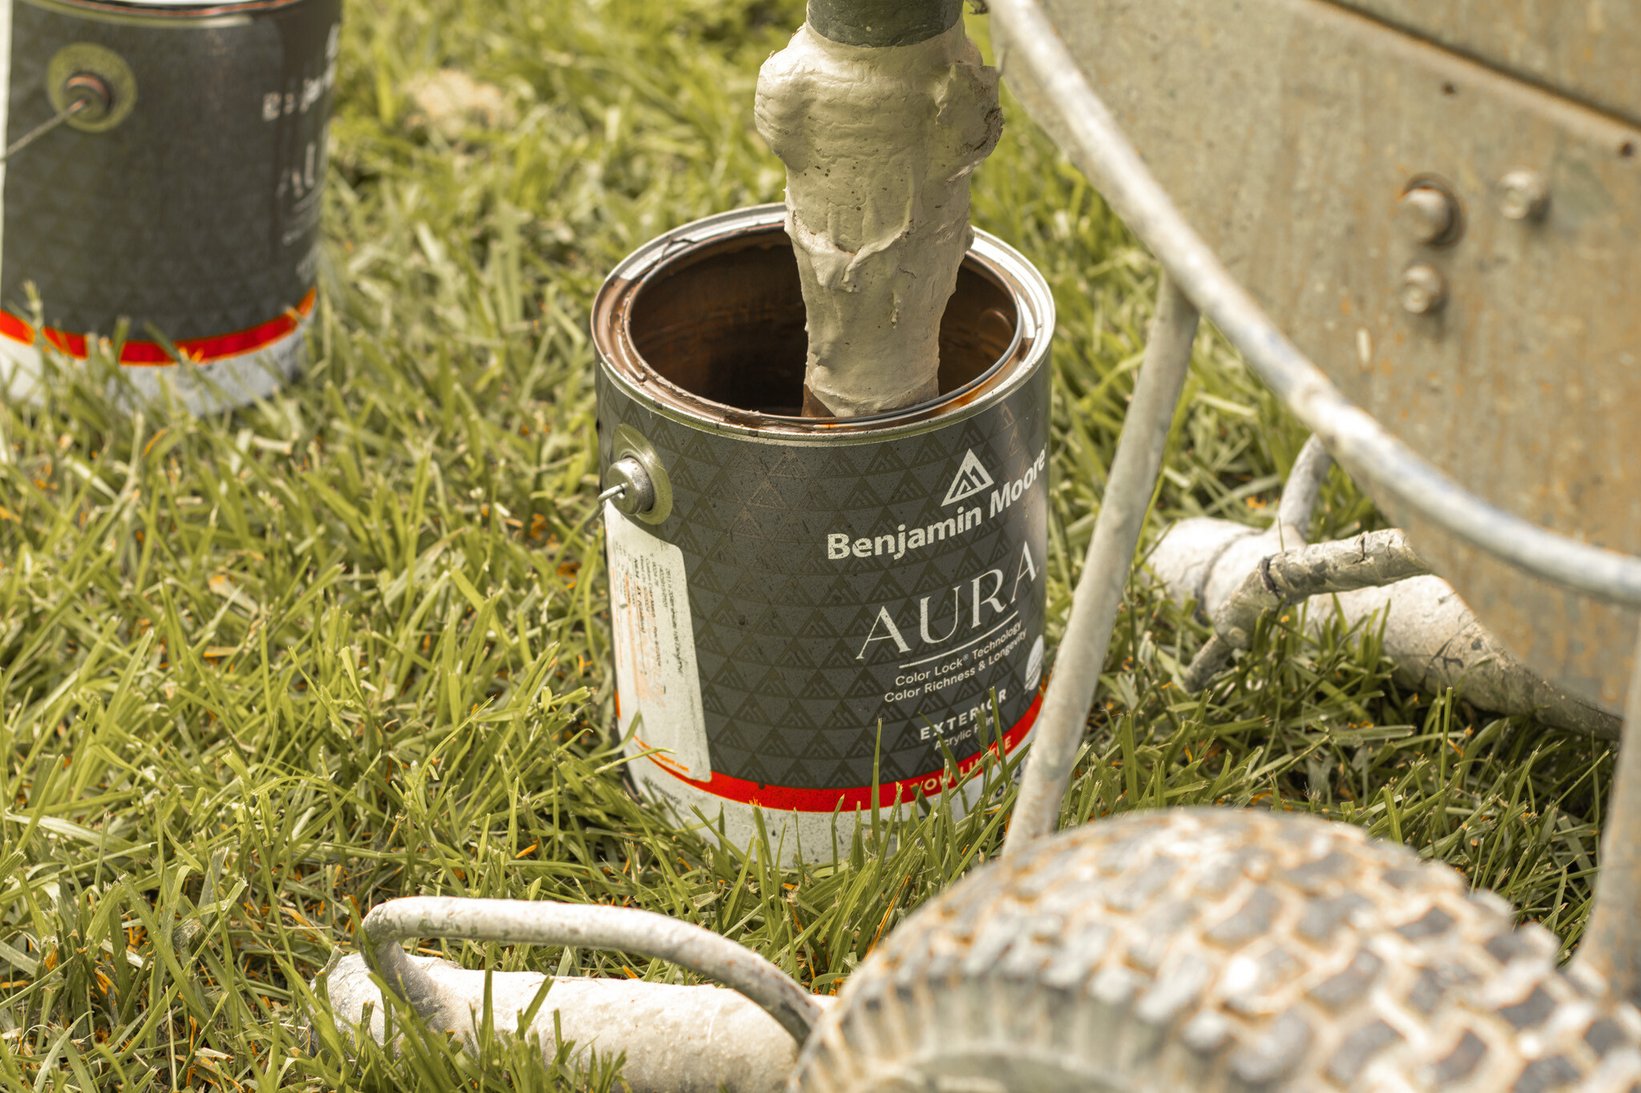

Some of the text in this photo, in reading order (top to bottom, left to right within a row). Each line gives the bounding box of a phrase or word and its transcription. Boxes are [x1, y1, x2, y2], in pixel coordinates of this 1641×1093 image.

[827, 449, 1046, 560] Benjamin Moore
[855, 541, 1037, 660] AURA
[884, 627, 1028, 703] Color Richness & Longevity
[895, 671, 931, 687] Color
[972, 620, 1022, 659] Technology
[934, 729, 972, 751] Acrylic
